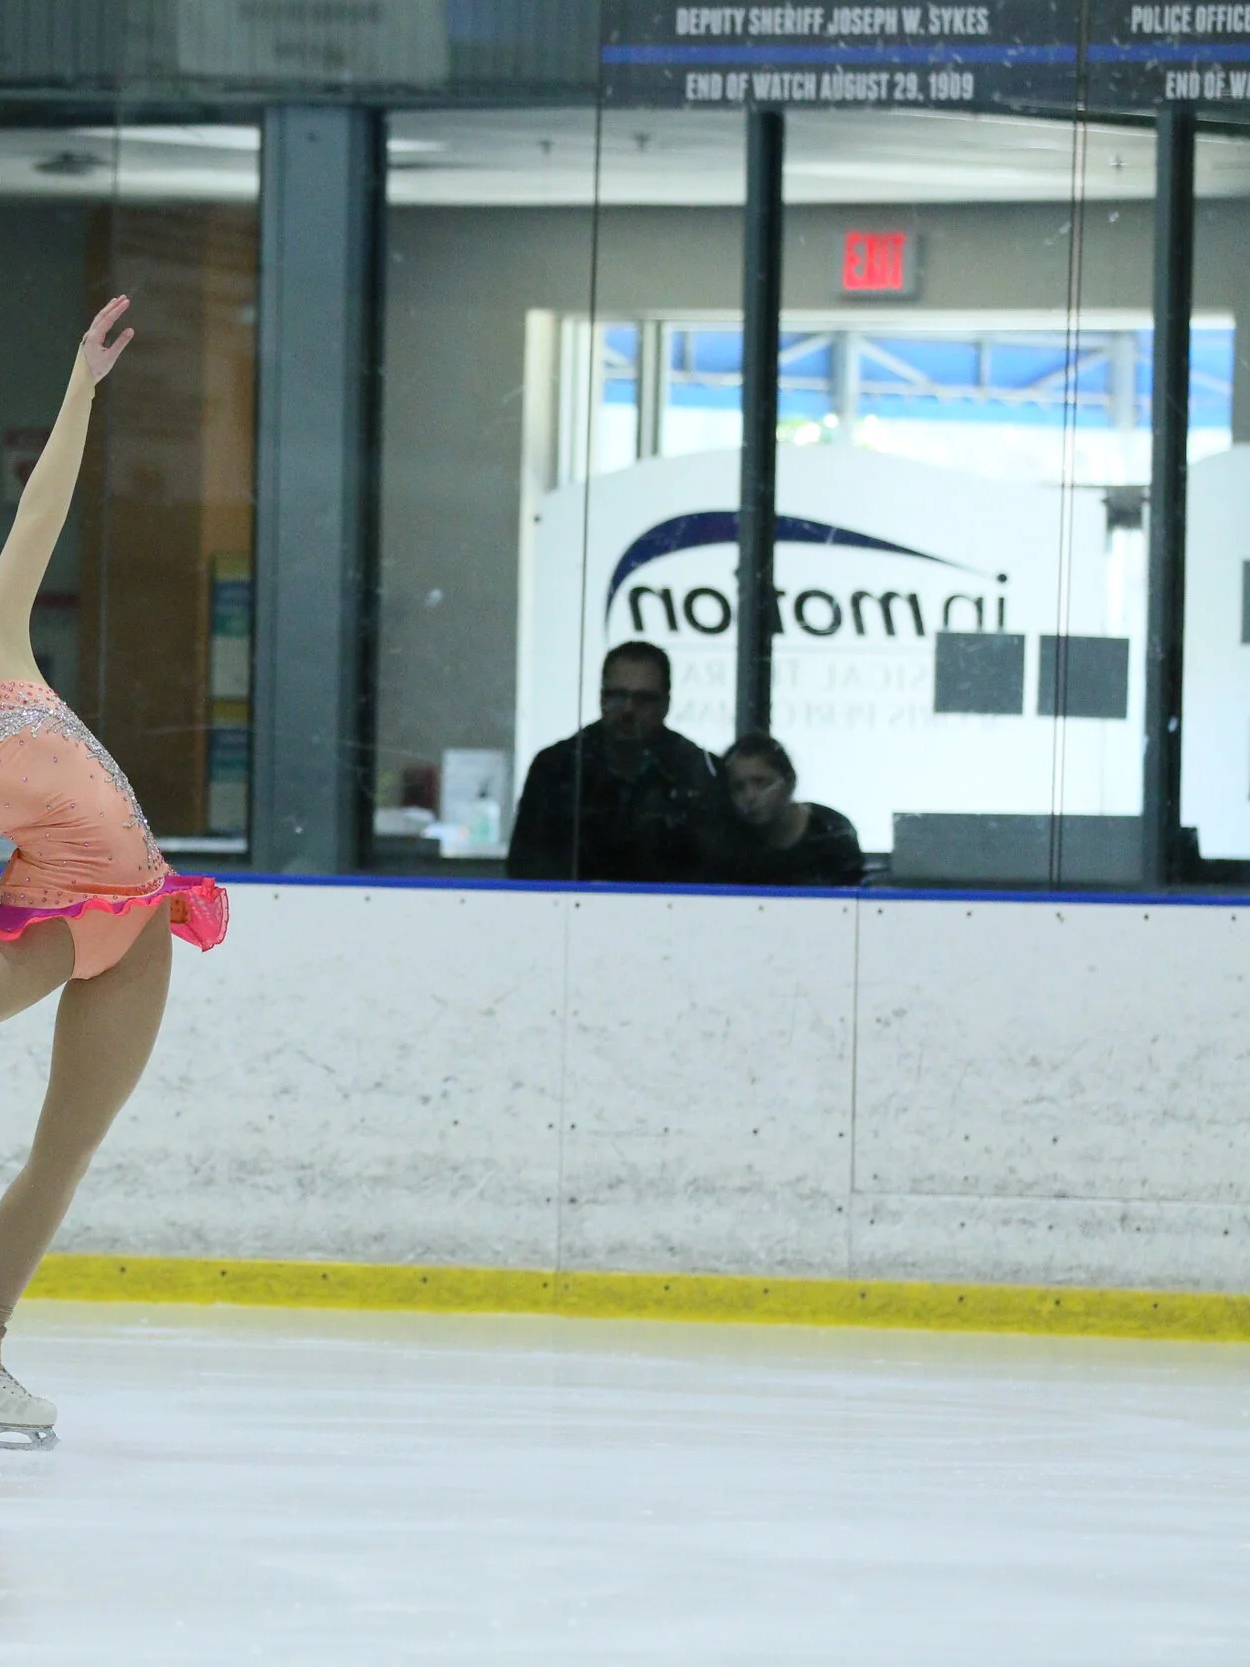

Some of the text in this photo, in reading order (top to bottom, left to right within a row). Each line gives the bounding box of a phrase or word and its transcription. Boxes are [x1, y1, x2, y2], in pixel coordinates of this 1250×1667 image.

[676, 6, 990, 36] DEPUTY SHERIFF JOSEPH W. SYKES
[1131, 5, 1191, 34] POLICE
[685, 72, 723, 100] END
[726, 72, 749, 100] OF
[752, 72, 817, 101] WATCH
[820, 71, 890, 101] AUGUST
[1165, 70, 1200, 100] END
[1203, 70, 1226, 100] OF
[843, 231, 906, 291] EXIT
